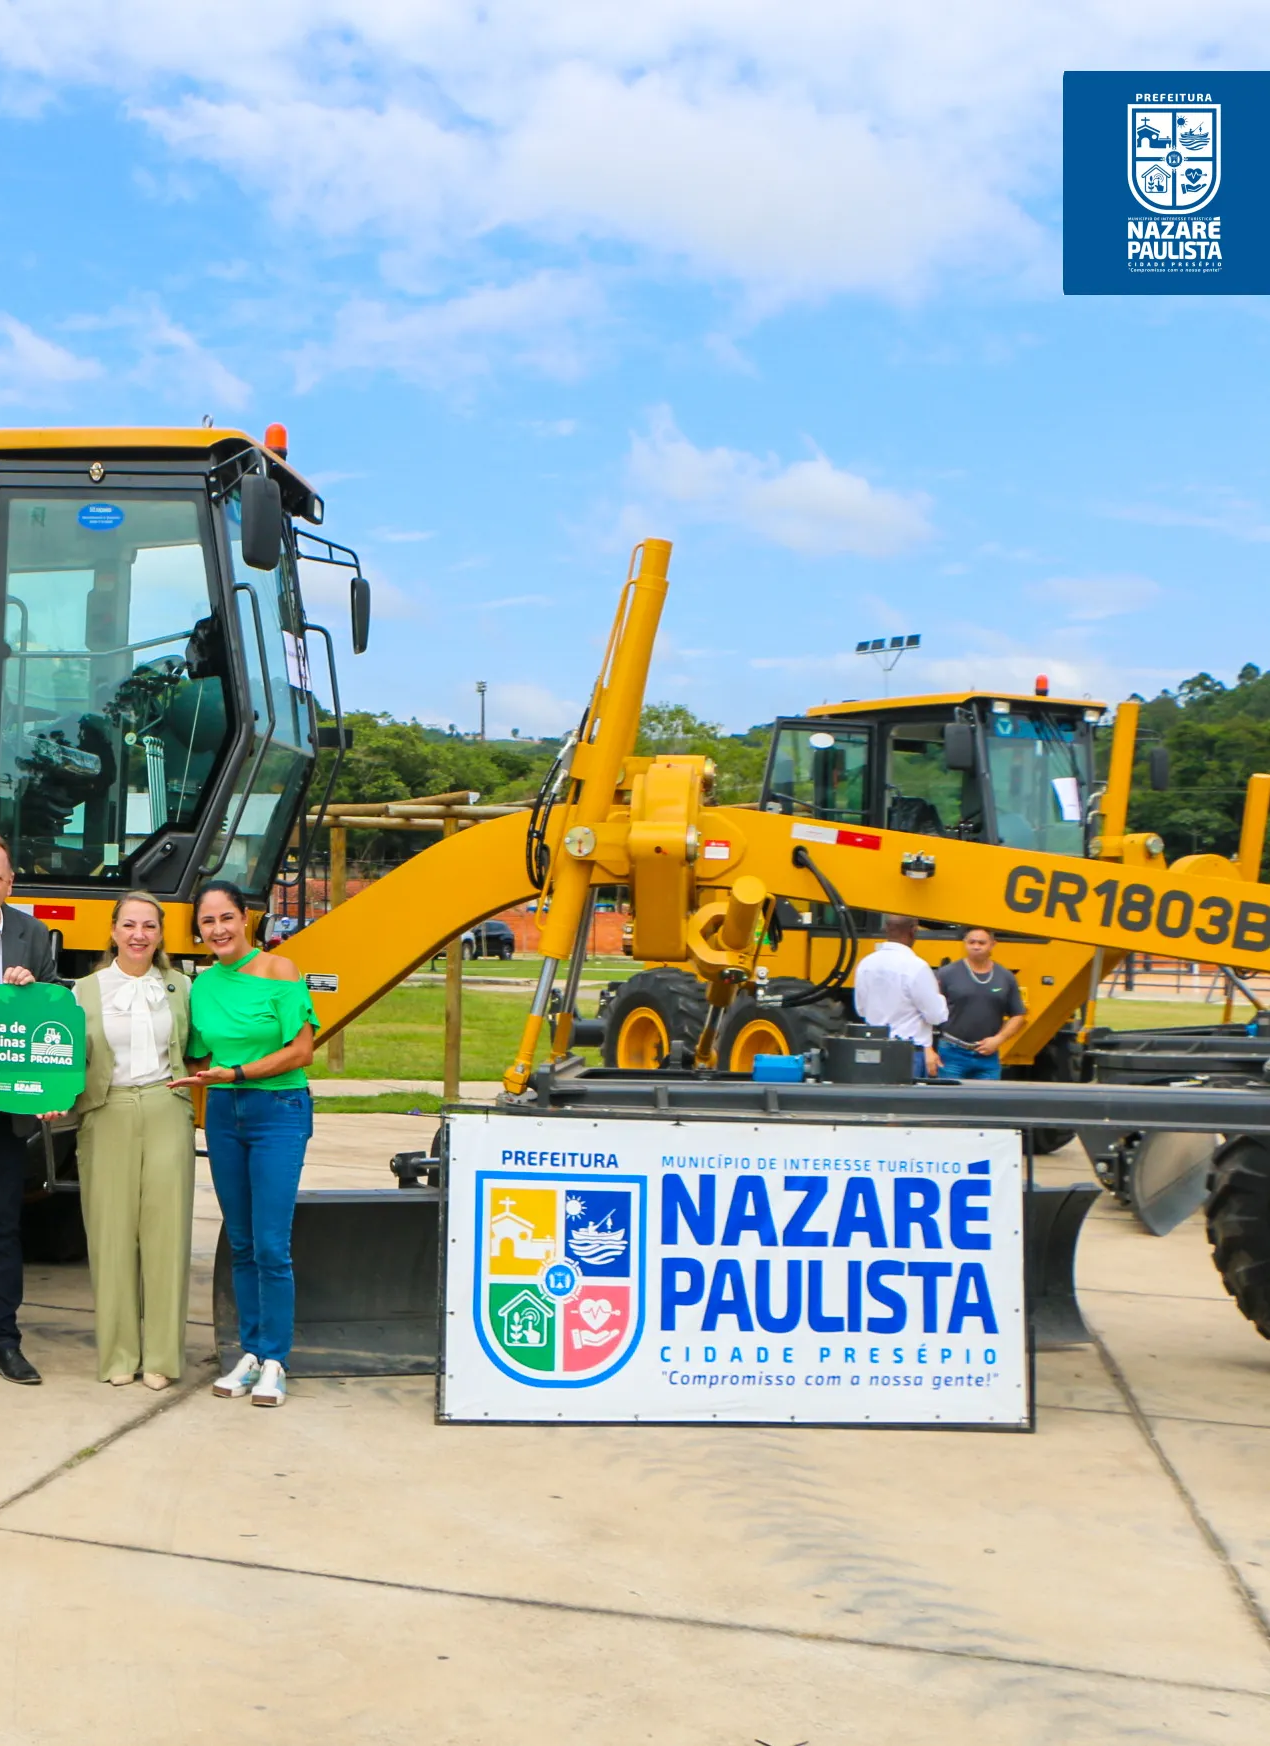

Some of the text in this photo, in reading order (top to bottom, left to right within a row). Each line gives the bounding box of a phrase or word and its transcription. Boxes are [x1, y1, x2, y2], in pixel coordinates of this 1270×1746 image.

[1004, 865, 1270, 952] GR1803B
[9, 1021, 27, 1034] de
[30, 1055, 73, 1066] PROMAQ
[501, 1149, 619, 1169] PREFEITURA
[661, 1154, 961, 1174] MUNICÍPIO DE INTERESSE TURÍSTICO
[660, 1159, 992, 1250] NAZARÉ
[660, 1256, 999, 1336] PAULISTA
[660, 1344, 997, 1365] CIDADE PRESÉPIO
[661, 1370, 999, 1391] "Compromisso com a nossa gente!"
